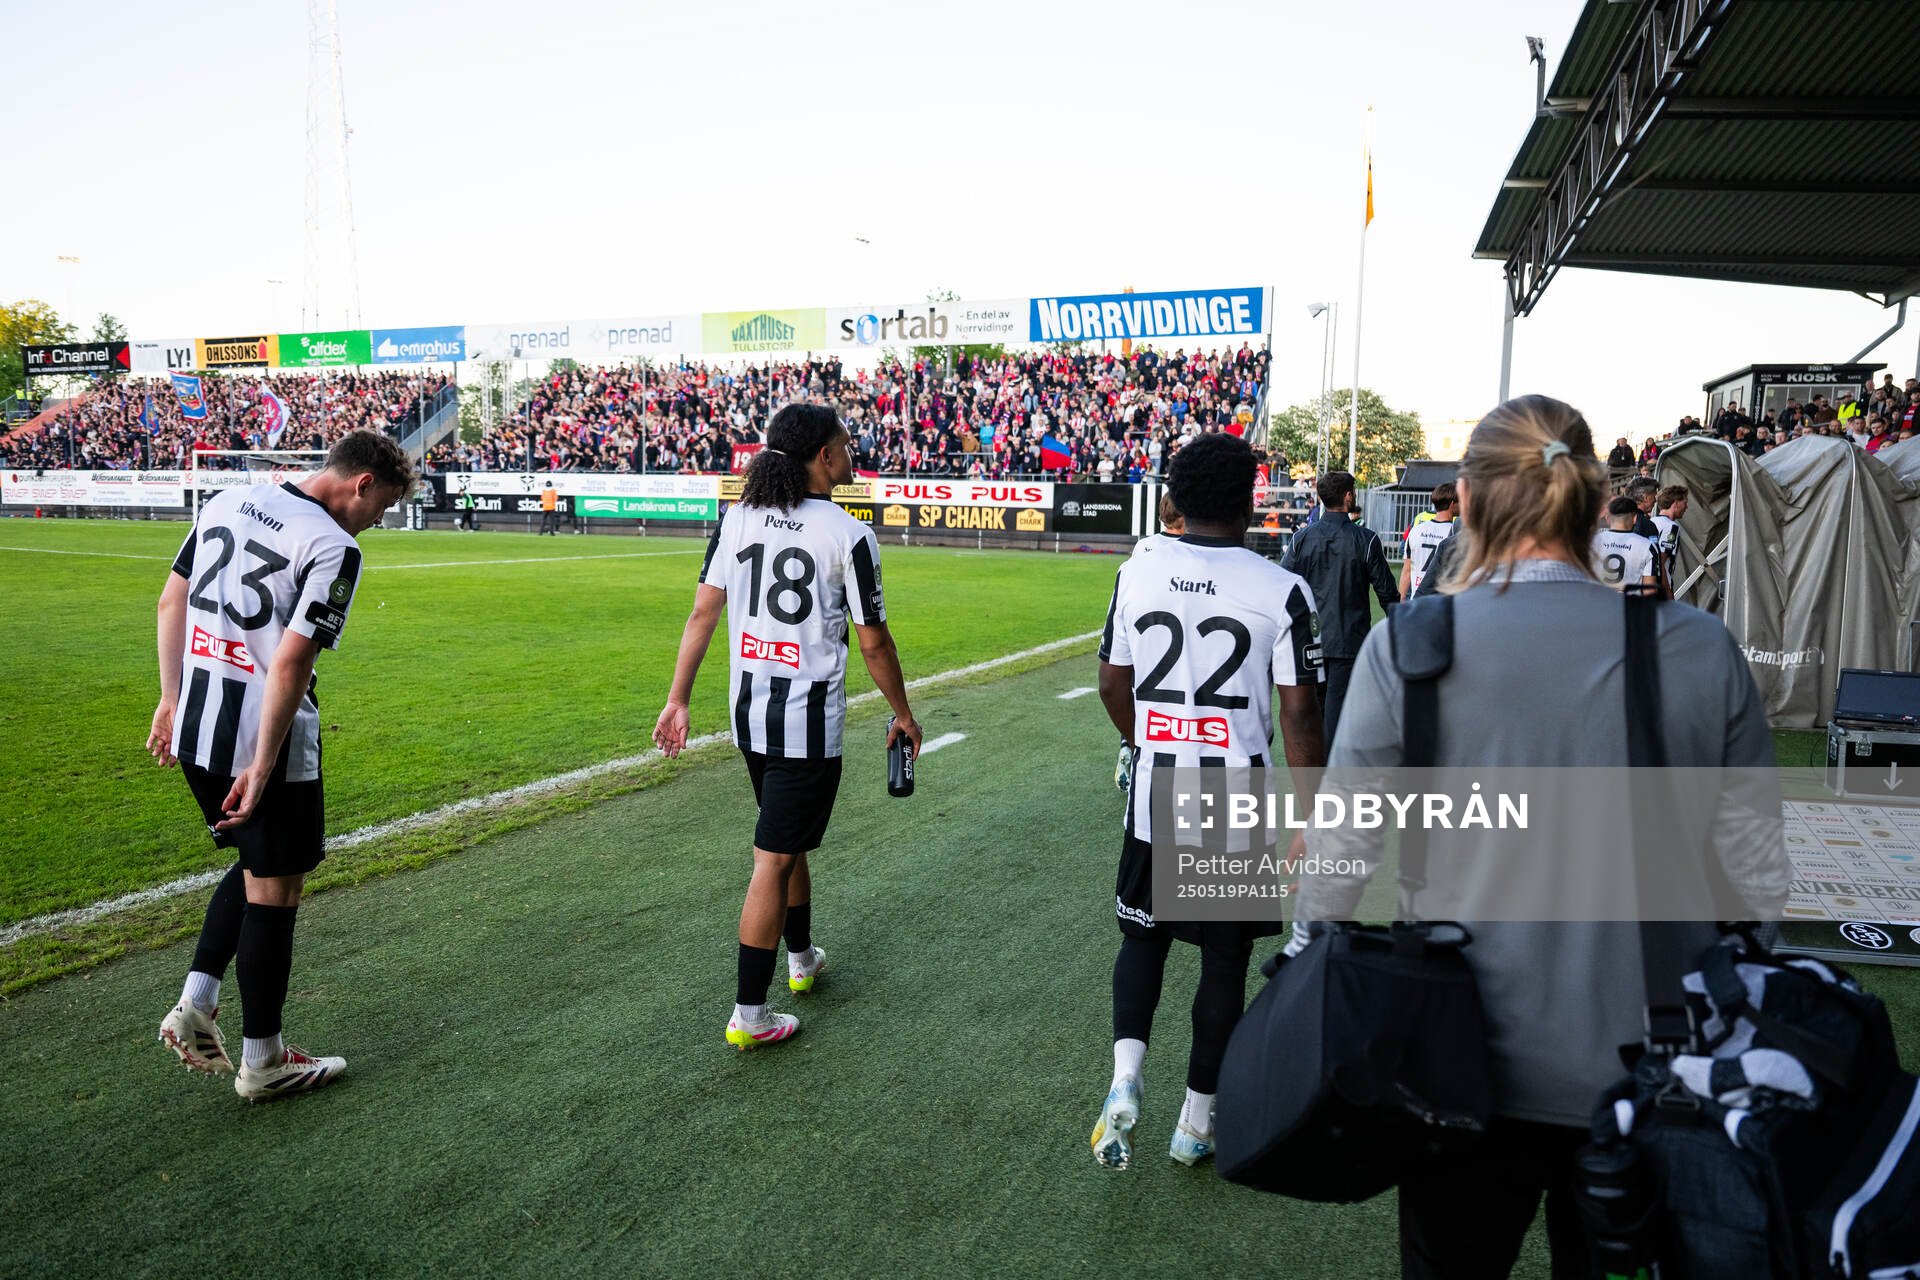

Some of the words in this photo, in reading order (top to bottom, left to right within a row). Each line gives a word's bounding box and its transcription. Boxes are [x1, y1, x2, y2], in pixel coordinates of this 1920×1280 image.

[840, 308, 948, 342] sortab
[966, 310, 978, 321] En
[982, 309, 996, 321] del
[998, 311, 1010, 320] av
[1038, 296, 1253, 339] NORRVIDINGE
[510, 326, 570, 350] prenad
[608, 320, 672, 350] prenad
[732, 314, 796, 342] VÄXTHUSET
[956, 321, 1014, 338] Norrvidinge
[27, 347, 110, 365] InfoChannel
[207, 345, 258, 362] OHLSSONS
[1787, 373, 1838, 383] KIOSK
[833, 485, 864, 494] HLSSONS
[885, 484, 952, 500] PULS
[971, 486, 1043, 502] PULS
[455, 497, 502, 511] sdium
[623, 500, 676, 513] Landskrona
[678, 502, 708, 516] Energi
[236, 501, 285, 533] Nilsson
[764, 514, 805, 532] Perez
[919, 505, 942, 528] SP
[945, 506, 1006, 531] CHARK
[189, 525, 291, 631] 23
[735, 543, 816, 626] 18
[1169, 576, 1218, 596] Stark
[193, 632, 255, 666] PULS
[743, 638, 799, 664] PULS
[1134, 610, 1252, 710] 22
[1149, 716, 1227, 743] PULS
[1789, 881, 1920, 899] UPERETTAN
